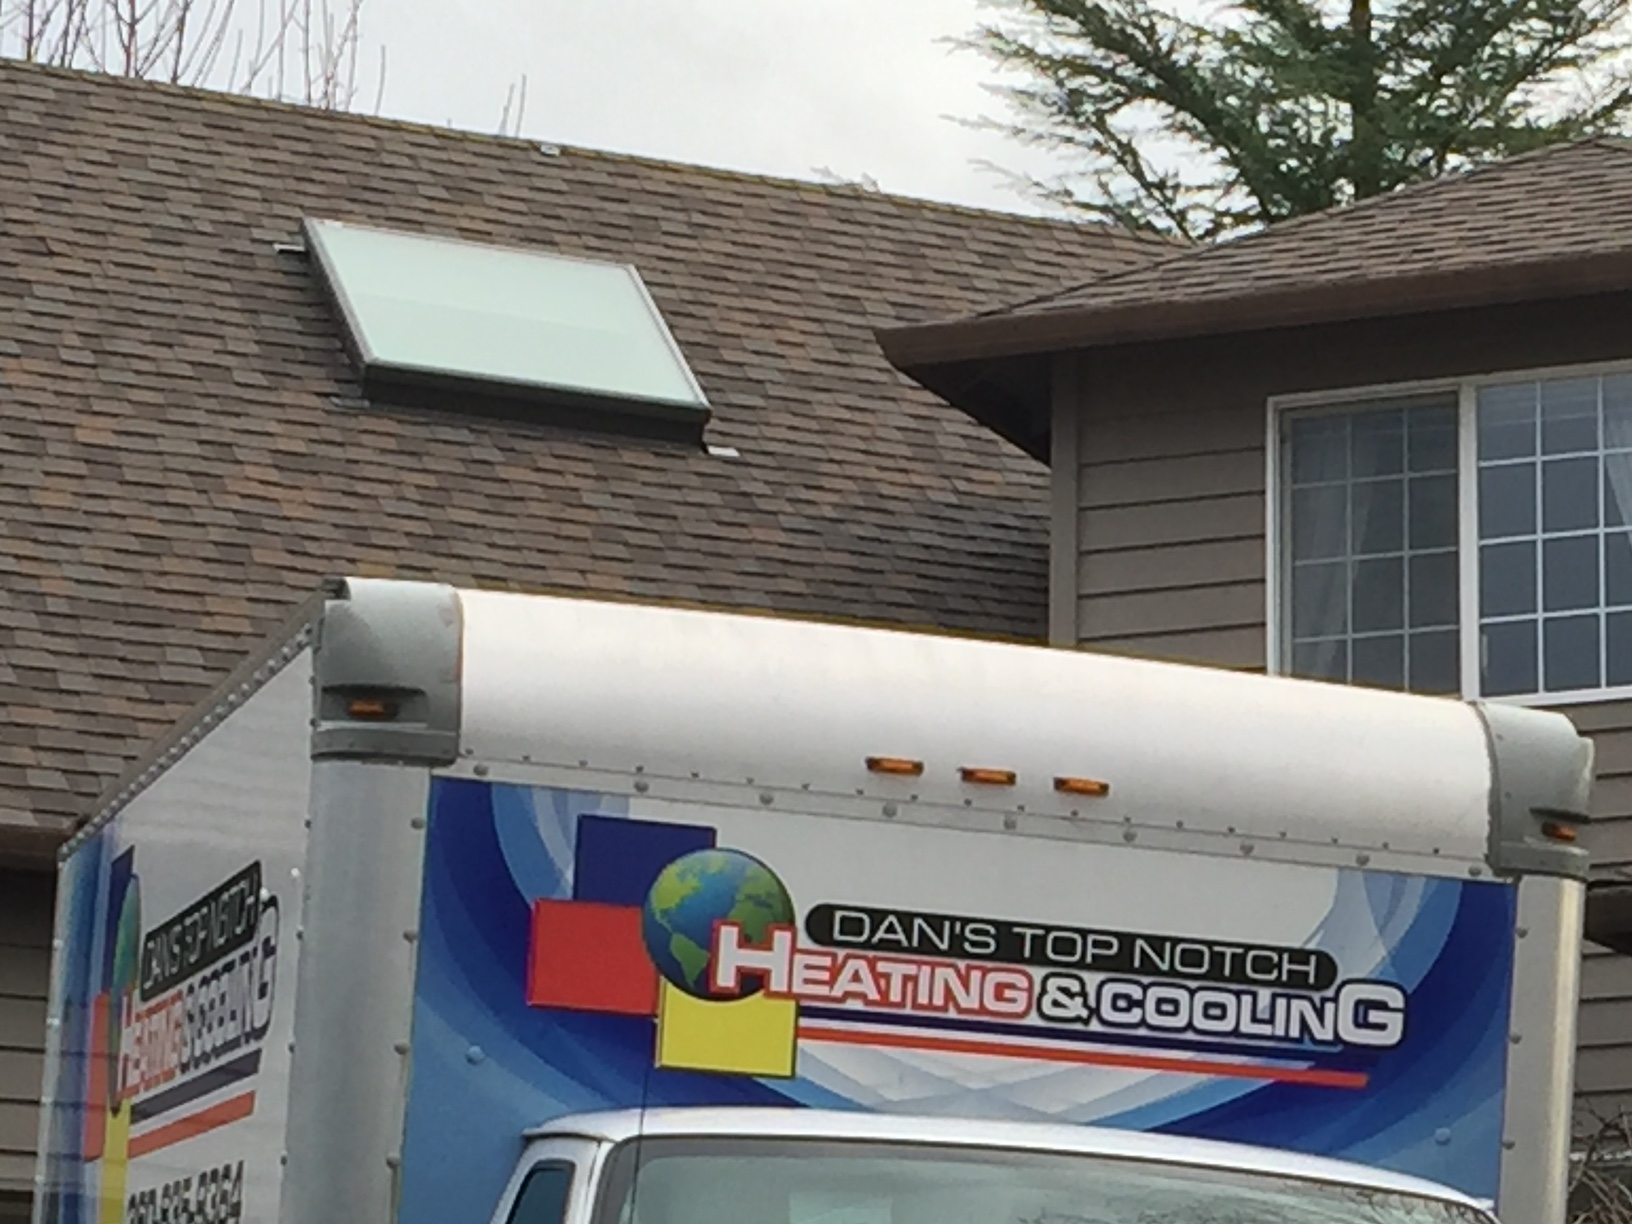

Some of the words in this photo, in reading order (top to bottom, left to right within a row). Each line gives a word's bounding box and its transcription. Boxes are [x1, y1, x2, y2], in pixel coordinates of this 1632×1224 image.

[833, 909, 997, 954] DAN'S
[1012, 926, 1119, 964] TOP
[1133, 938, 1316, 985] NOTCH
